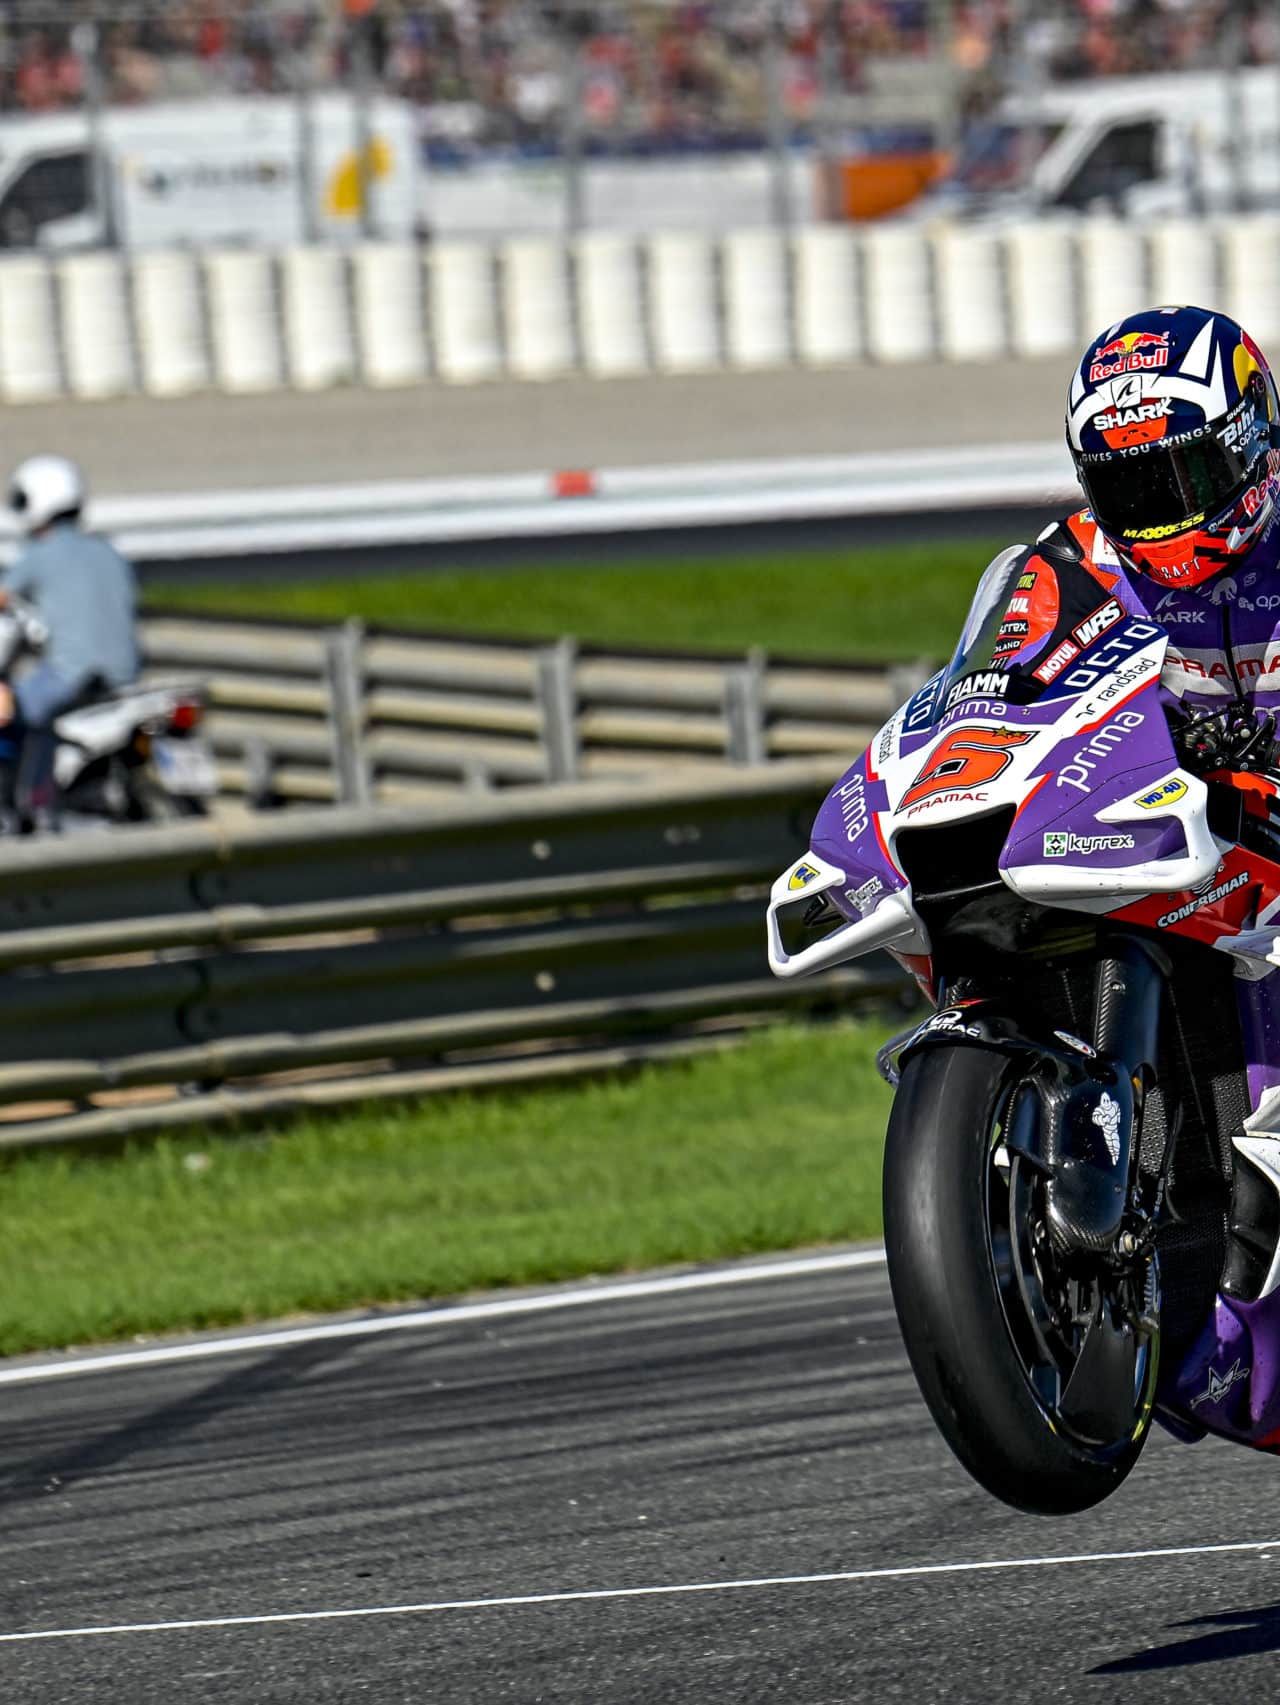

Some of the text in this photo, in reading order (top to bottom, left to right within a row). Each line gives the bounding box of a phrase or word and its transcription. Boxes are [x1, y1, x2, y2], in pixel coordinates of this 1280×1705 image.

[1090, 348, 1168, 382] Red Bull
[1093, 397, 1175, 431] SHARK
[1120, 443, 1150, 458] YOU
[1158, 424, 1212, 448] WINGS
[1075, 600, 1121, 645] WRS
[1038, 644, 1079, 681] MOTUL
[1064, 624, 1158, 687] OCTO
[946, 673, 1010, 708] FIAMM
[1096, 658, 1157, 701] randstad
[938, 701, 1007, 734] prima
[1057, 711, 1145, 792] prima
[832, 774, 868, 842] prima
[908, 793, 989, 818] PRAMAC
[1140, 781, 1182, 805] WD-40
[1158, 872, 1249, 928] CONFREMAR
